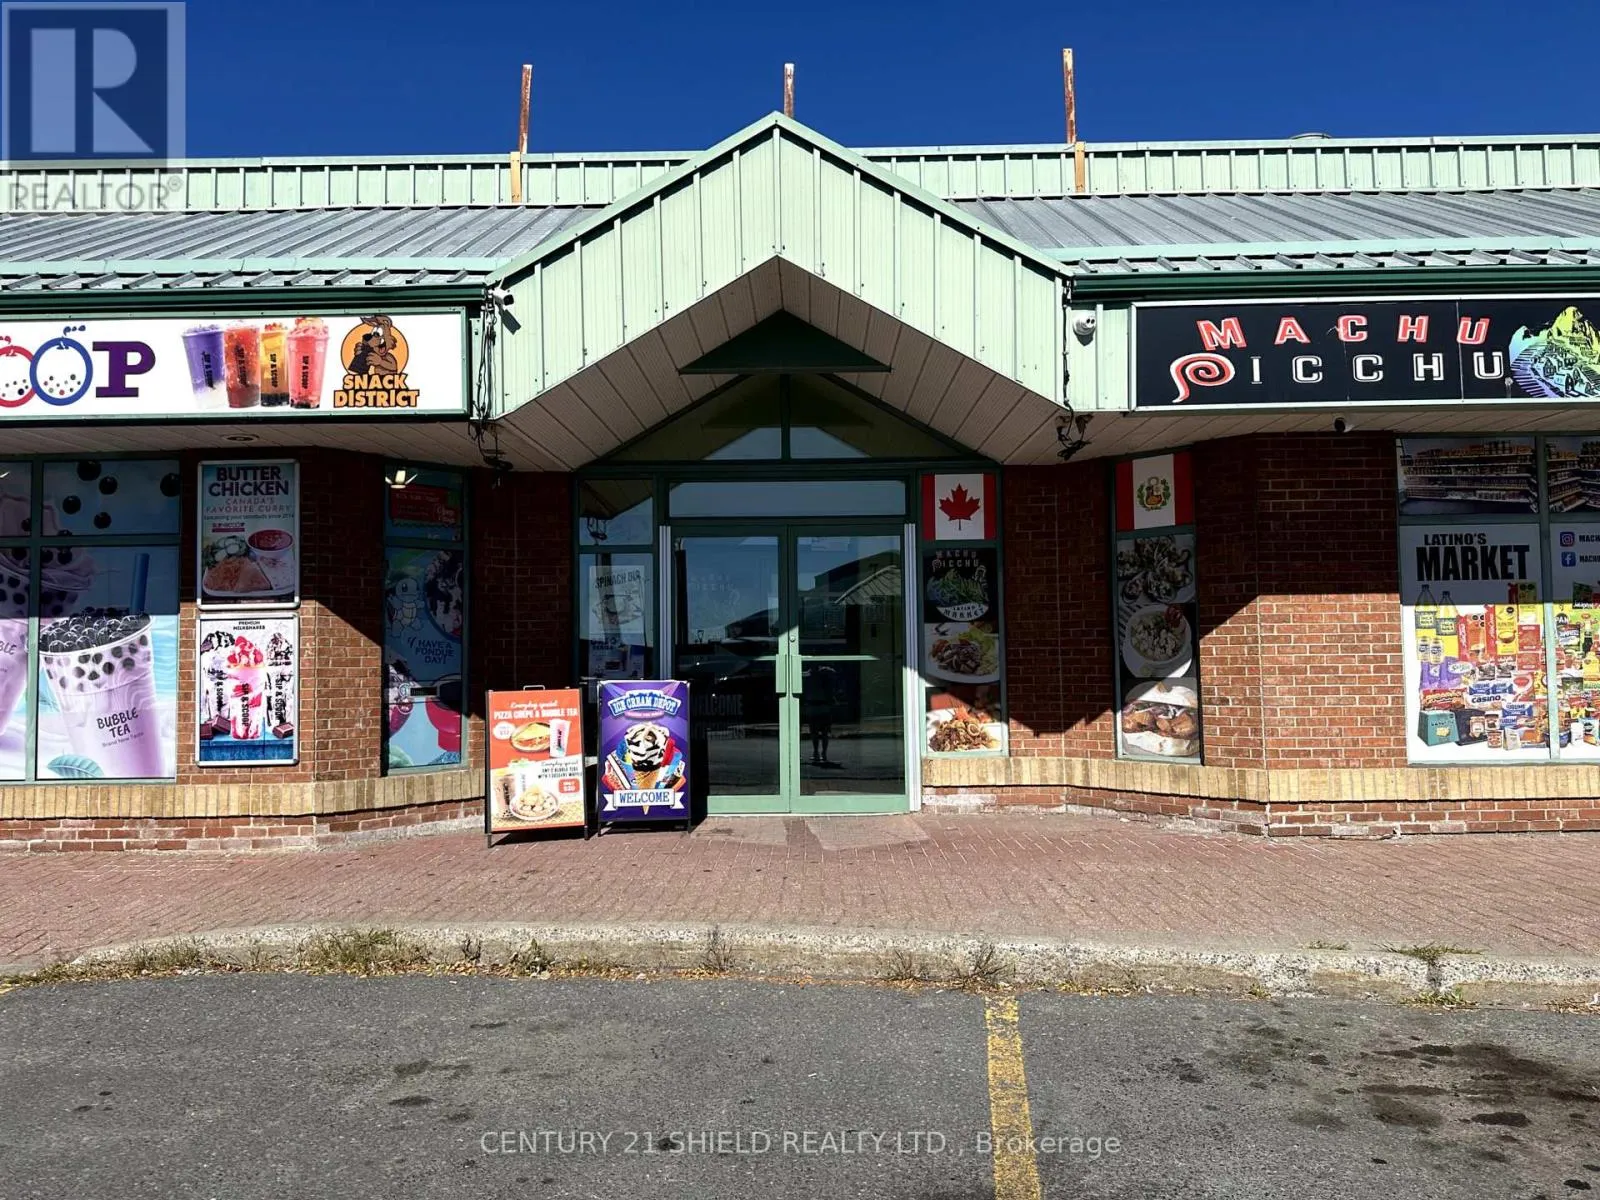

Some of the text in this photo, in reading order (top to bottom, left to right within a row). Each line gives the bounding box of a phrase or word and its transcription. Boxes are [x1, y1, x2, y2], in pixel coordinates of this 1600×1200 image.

[1197, 314, 1491, 350] MACHU
[343, 373, 408, 391] SNACK
[1169, 352, 1504, 403] PICCHU
[334, 389, 420, 407] DISTRICT
[216, 466, 281, 481] BUTTER
[208, 481, 289, 497] CHICKEN
[1424, 533, 1487, 545] LATINO'S
[1416, 545, 1530, 581] MARKET
[613, 696, 677, 713] ICE CREAM DEPOT
[1471, 695, 1501, 703] casino
[96, 707, 139, 729] BUBBLE
[109, 724, 131, 738] TEA
[619, 790, 670, 804] WELCOME
